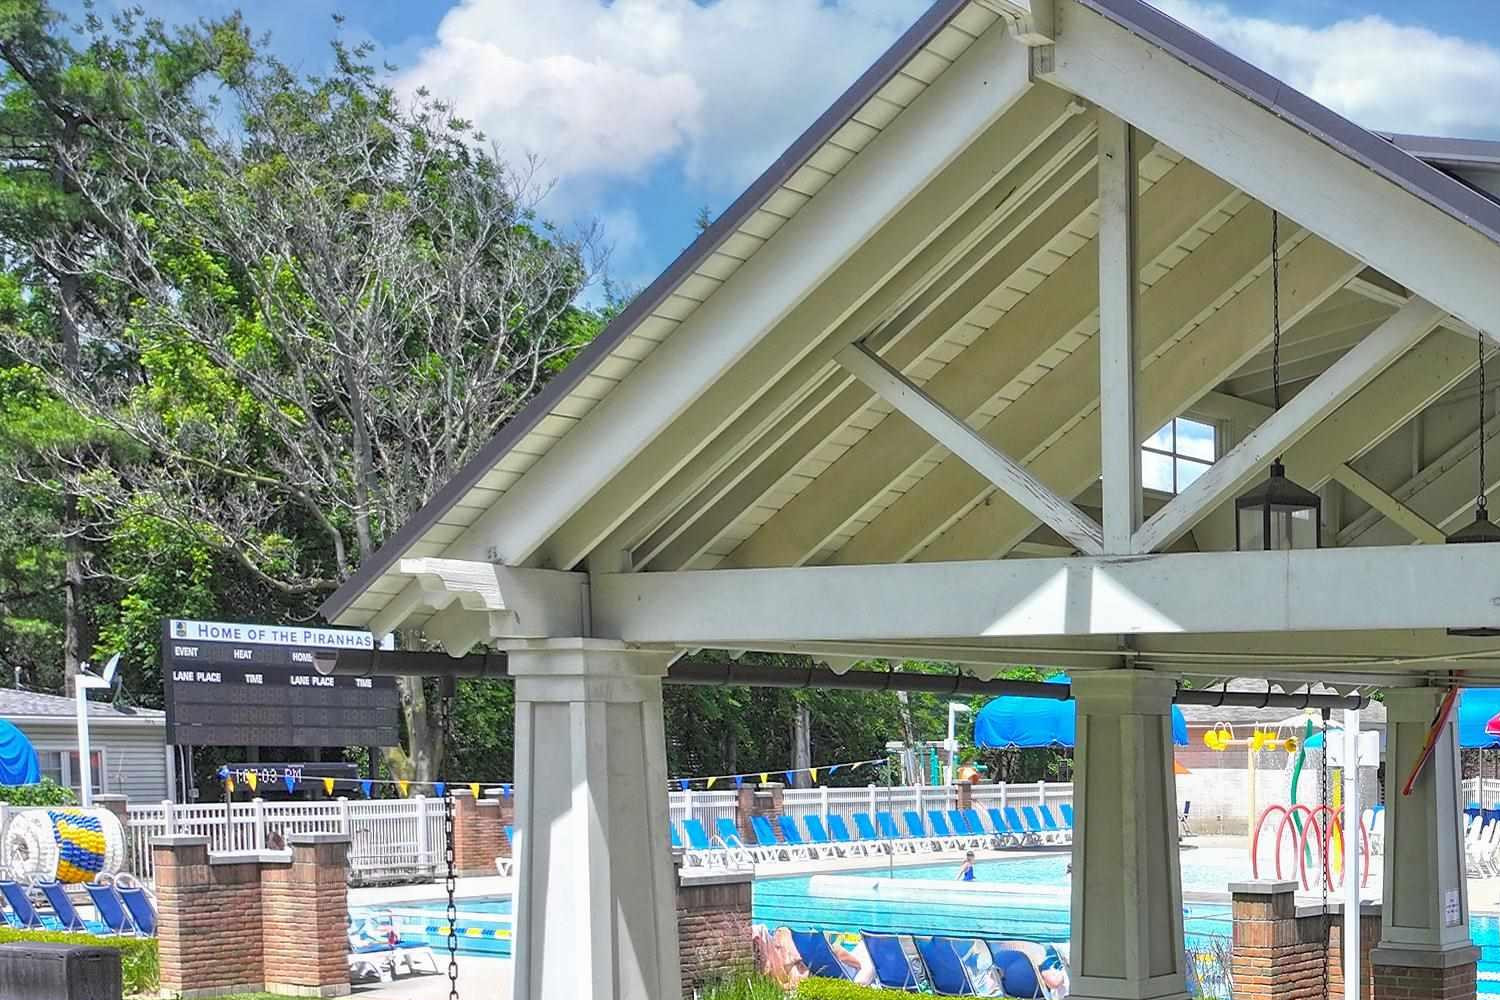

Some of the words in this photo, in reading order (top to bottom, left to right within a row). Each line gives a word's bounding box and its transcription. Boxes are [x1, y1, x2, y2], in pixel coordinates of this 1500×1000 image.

[198, 624, 241, 639] HOME
[247, 629, 265, 641] OF
[271, 631, 297, 642] THE
[303, 631, 371, 646] PIRANHAS
[175, 646, 198, 657] EVENT
[233, 649, 253, 659] HEAT
[173, 671, 194, 681] LANE
[197, 672, 221, 682] PLACE
[244, 674, 263, 684] TIME
[290, 676, 309, 685] LANE
[311, 676, 334, 687] PLACE
[354, 678, 372, 688] TIME
[284, 768, 301, 783] PM
